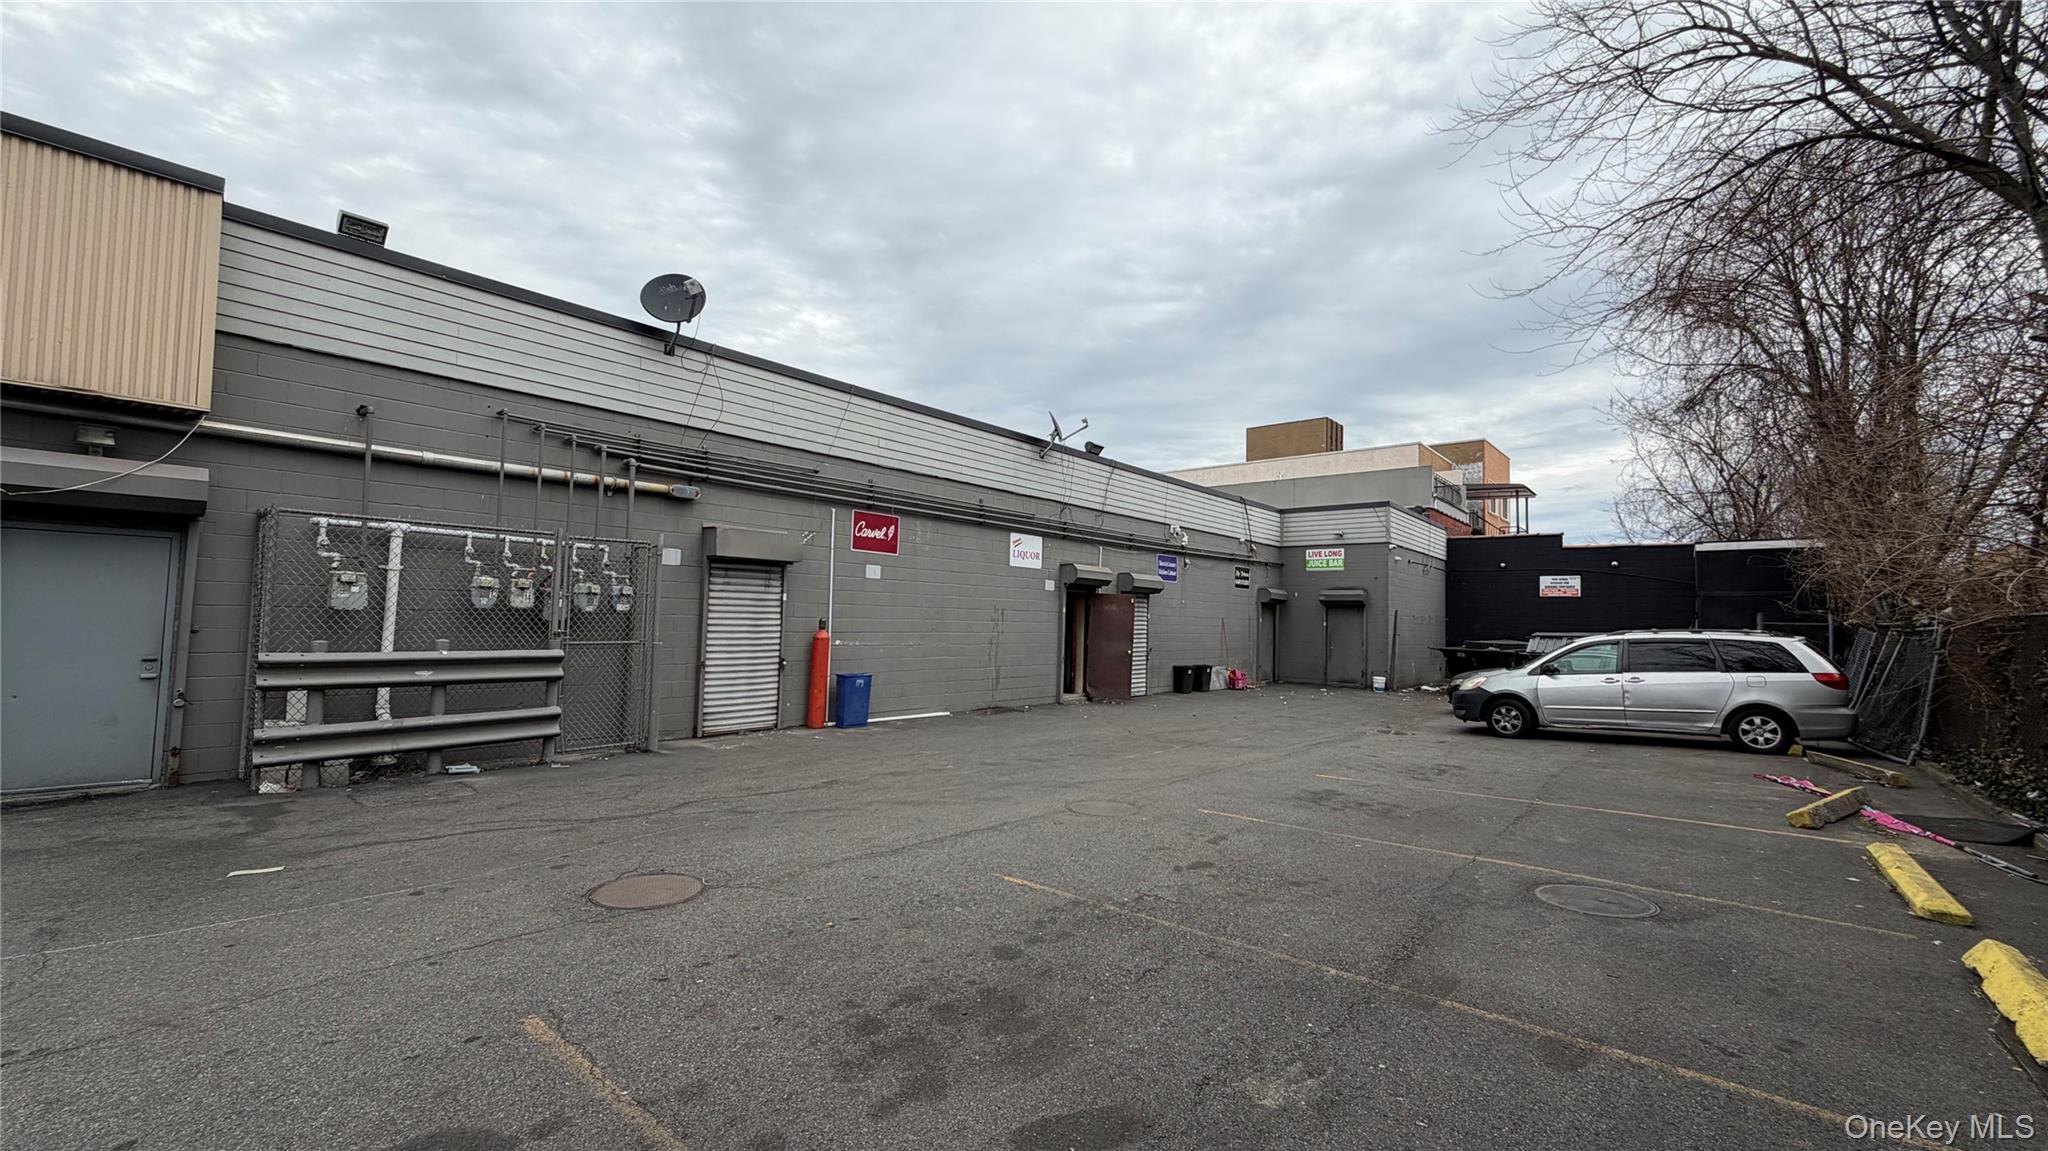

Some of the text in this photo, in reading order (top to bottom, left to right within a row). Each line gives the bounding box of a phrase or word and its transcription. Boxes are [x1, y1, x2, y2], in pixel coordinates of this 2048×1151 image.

[855, 521, 887, 540] Carvel
[1012, 550, 1041, 561] LIQUOR
[1324, 550, 1342, 558] LONG
[1307, 559, 1344, 567] JUICE BAR
